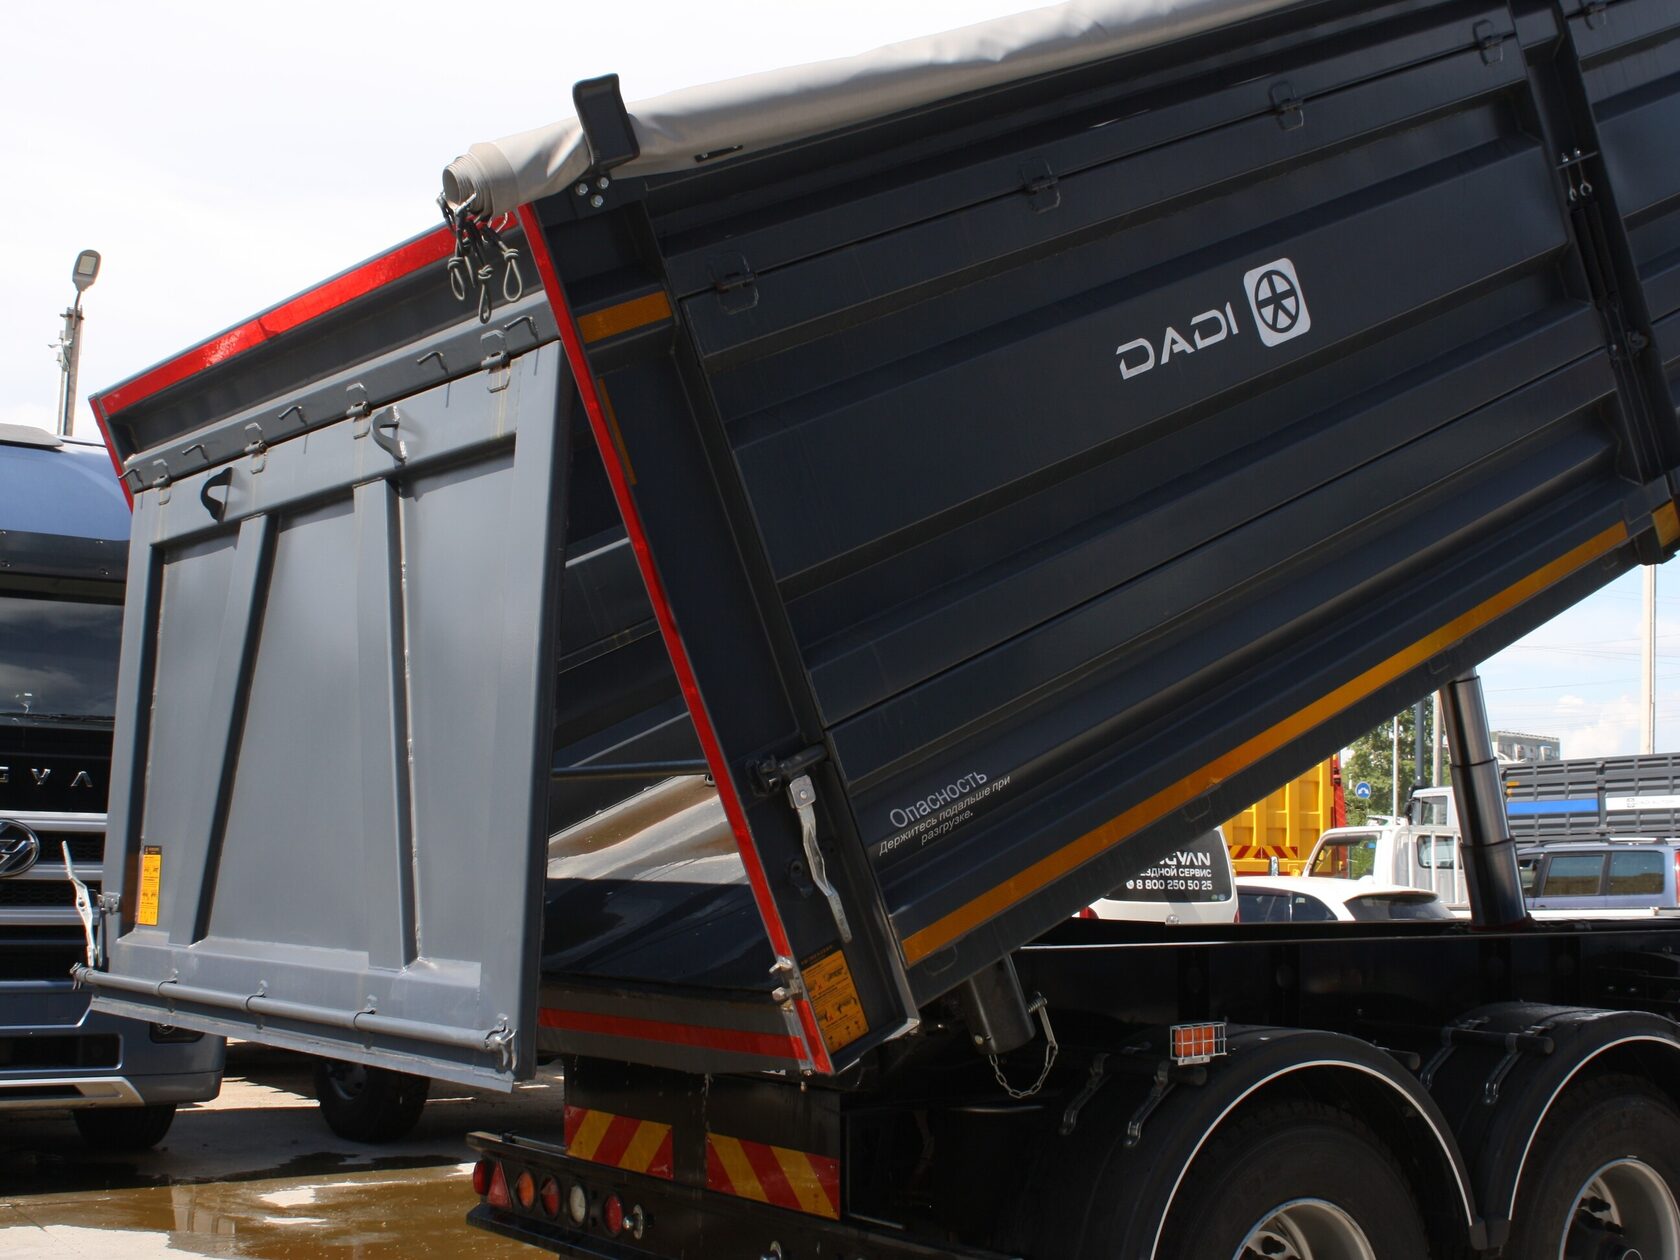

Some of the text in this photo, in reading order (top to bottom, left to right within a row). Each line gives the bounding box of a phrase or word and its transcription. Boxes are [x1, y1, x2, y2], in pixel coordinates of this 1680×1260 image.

[1115, 301, 1239, 380] DADI
[879, 774, 1011, 856] Держитесь подальше при
[889, 771, 988, 828] Опасность
[921, 810, 974, 845] разгрузке.
[1136, 879, 1213, 891] 8 800 250 50 25
[1140, 865, 1212, 878] ЗДНОЙ СЕРВИС
